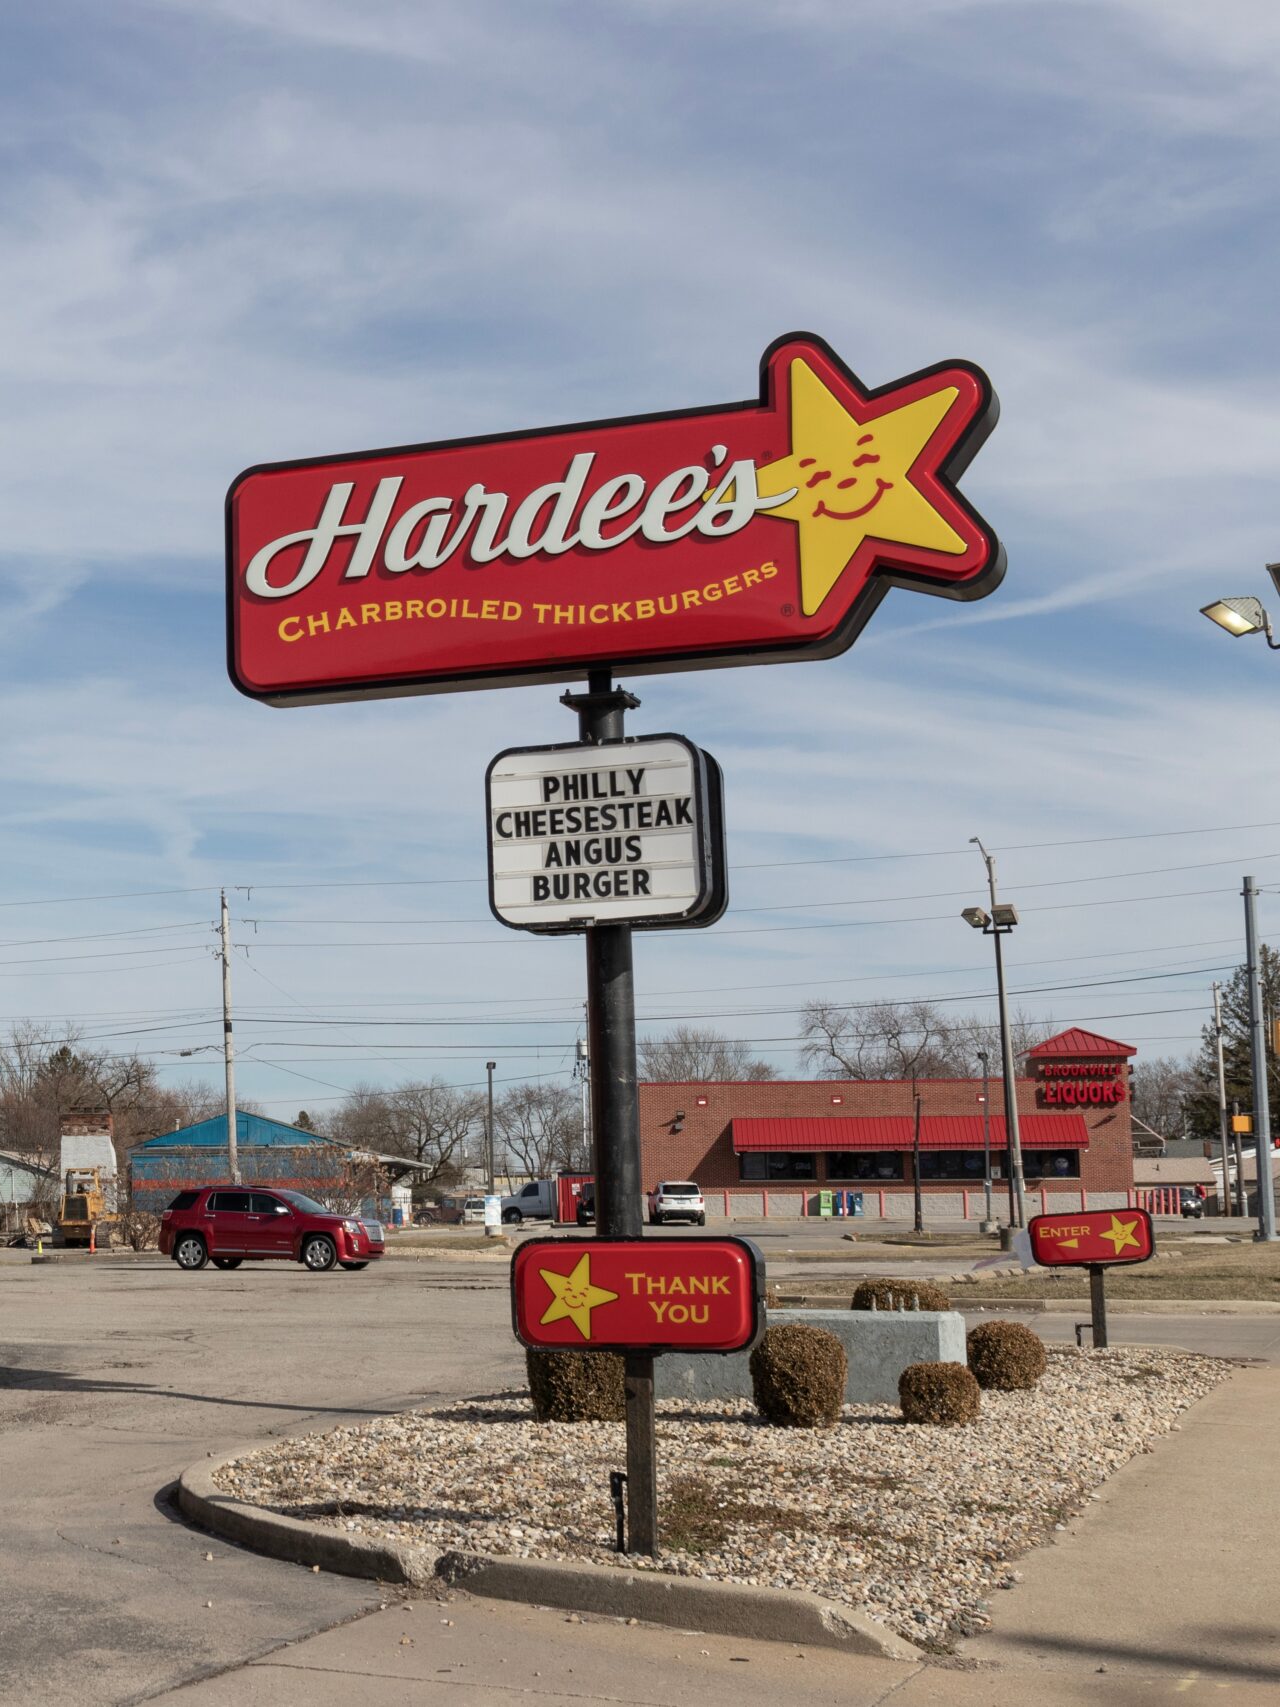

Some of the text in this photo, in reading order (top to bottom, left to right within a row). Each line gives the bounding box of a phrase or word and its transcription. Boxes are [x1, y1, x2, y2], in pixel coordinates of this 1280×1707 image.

[246, 444, 799, 598] Hardee's
[277, 561, 778, 642] CHARBROILED THICKBURGERS
[543, 768, 645, 802] PHILLY
[495, 797, 693, 838] CHEESESTEAK
[545, 836, 642, 868] ANGUS
[533, 869, 651, 901] BURGER
[1044, 1064, 1122, 1076] BROOKVILLE
[1045, 1081, 1126, 1105] LIQUORS
[1039, 1226, 1090, 1238] ENTER
[625, 1273, 731, 1296] THANK
[648, 1301, 709, 1324] YOU
